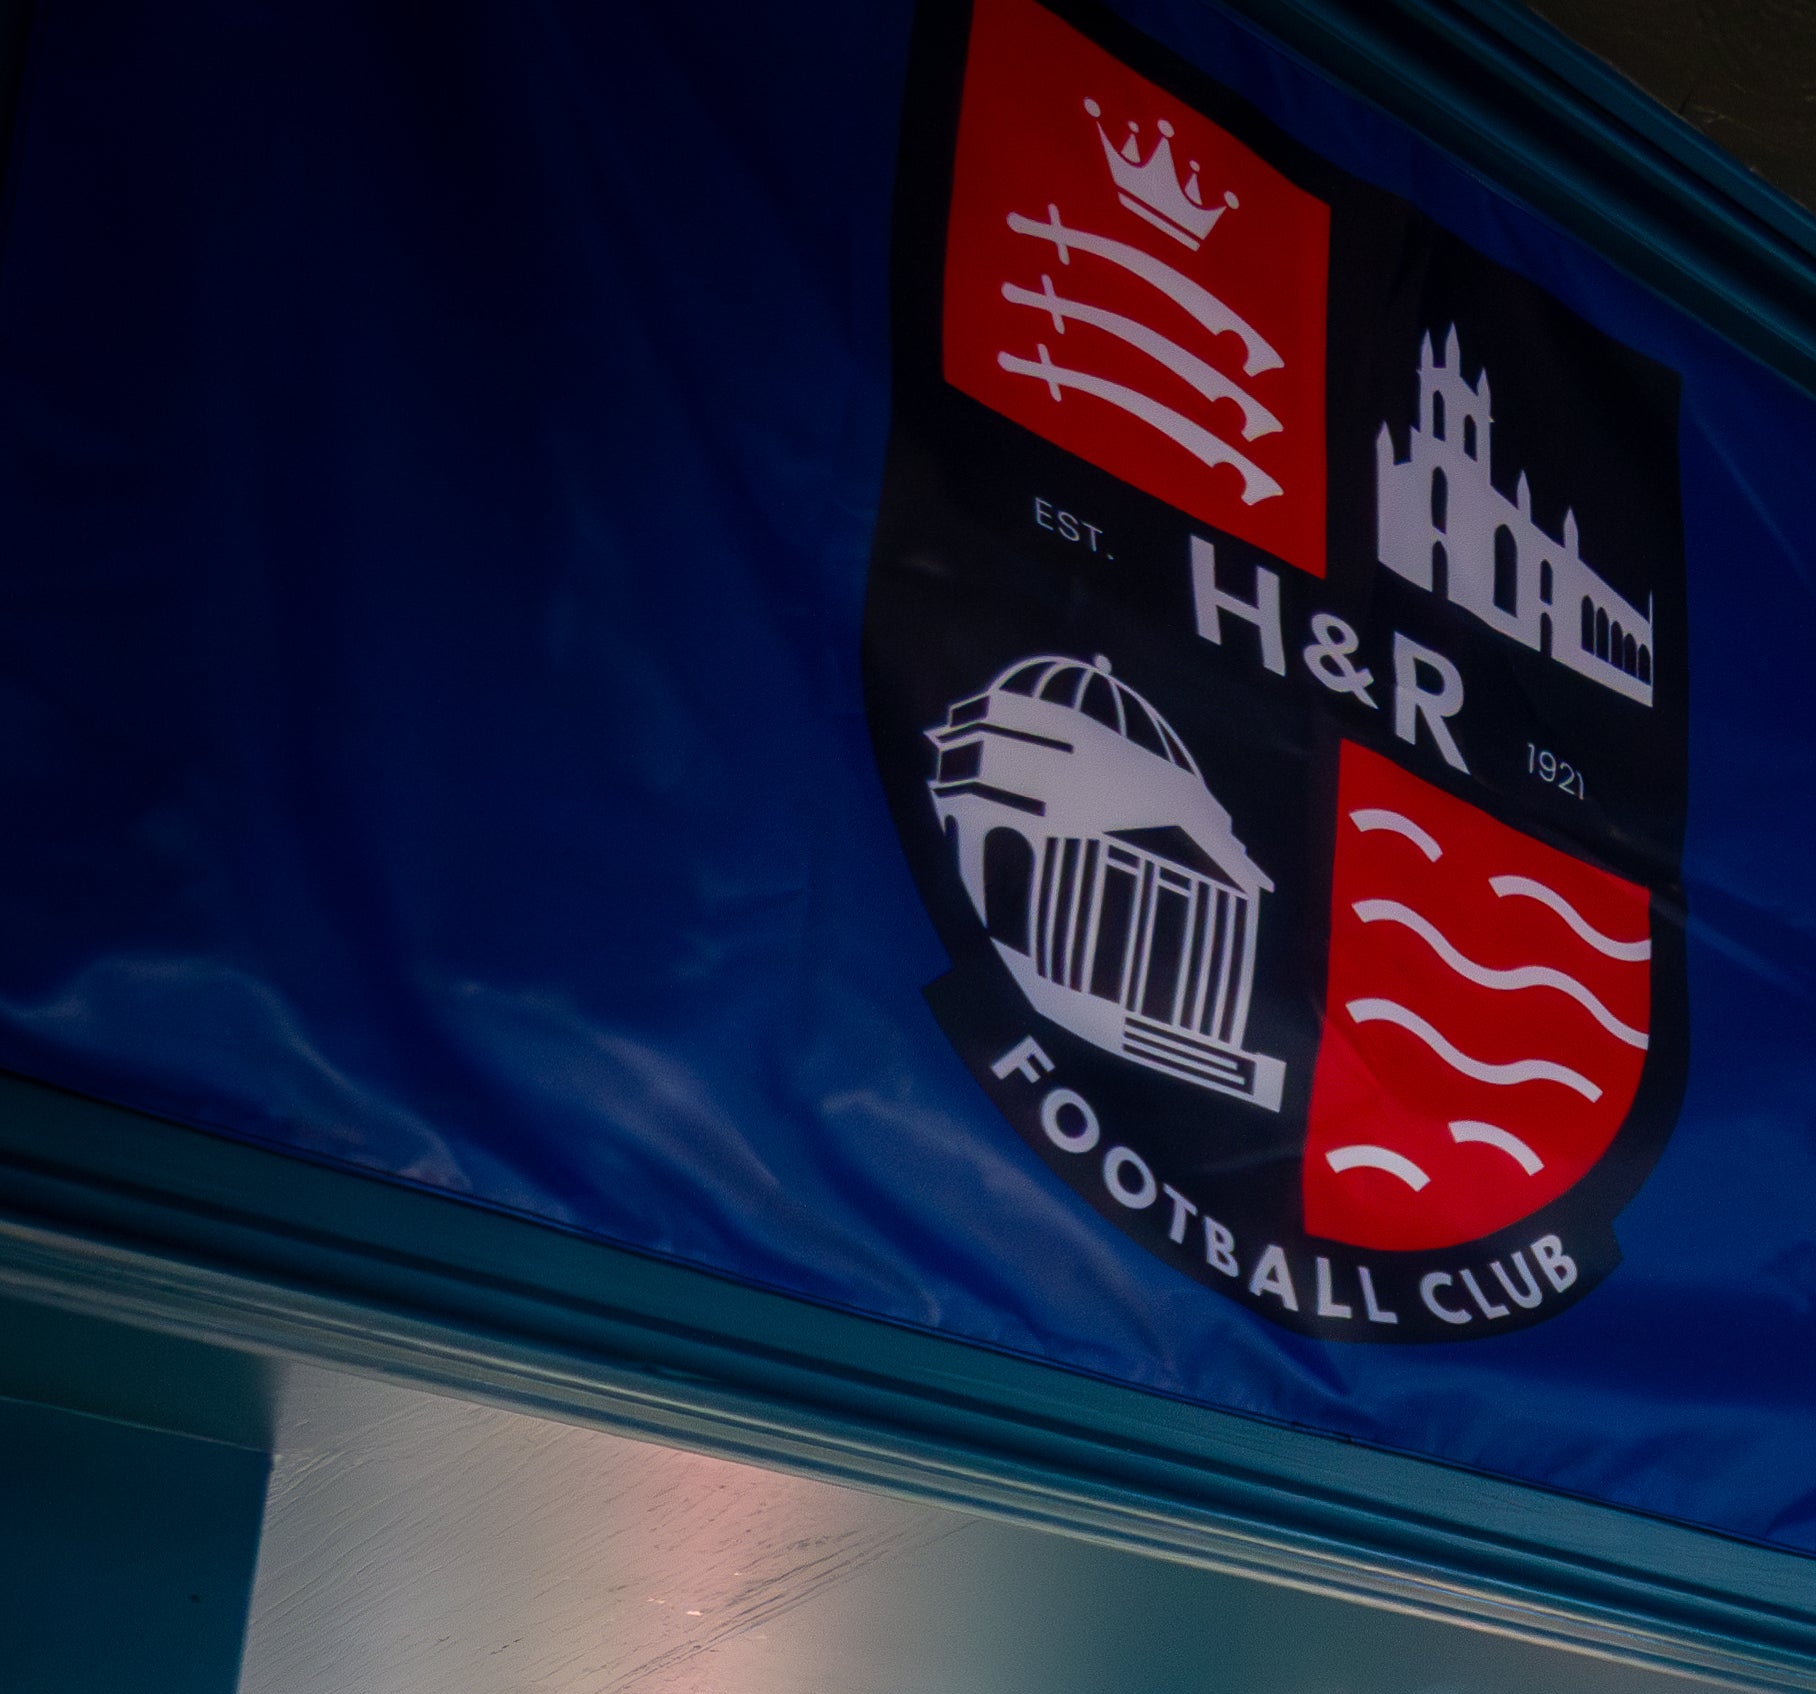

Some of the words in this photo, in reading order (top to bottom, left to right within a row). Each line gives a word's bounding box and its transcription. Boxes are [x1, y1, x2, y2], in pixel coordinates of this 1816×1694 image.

[1033, 496, 1114, 560] EST.
[1188, 534, 1472, 775] H&R
[1526, 742, 1585, 801] 1921
[990, 1034, 1399, 1326] FOOTBALL
[1418, 1233, 1579, 1327] CLUB
